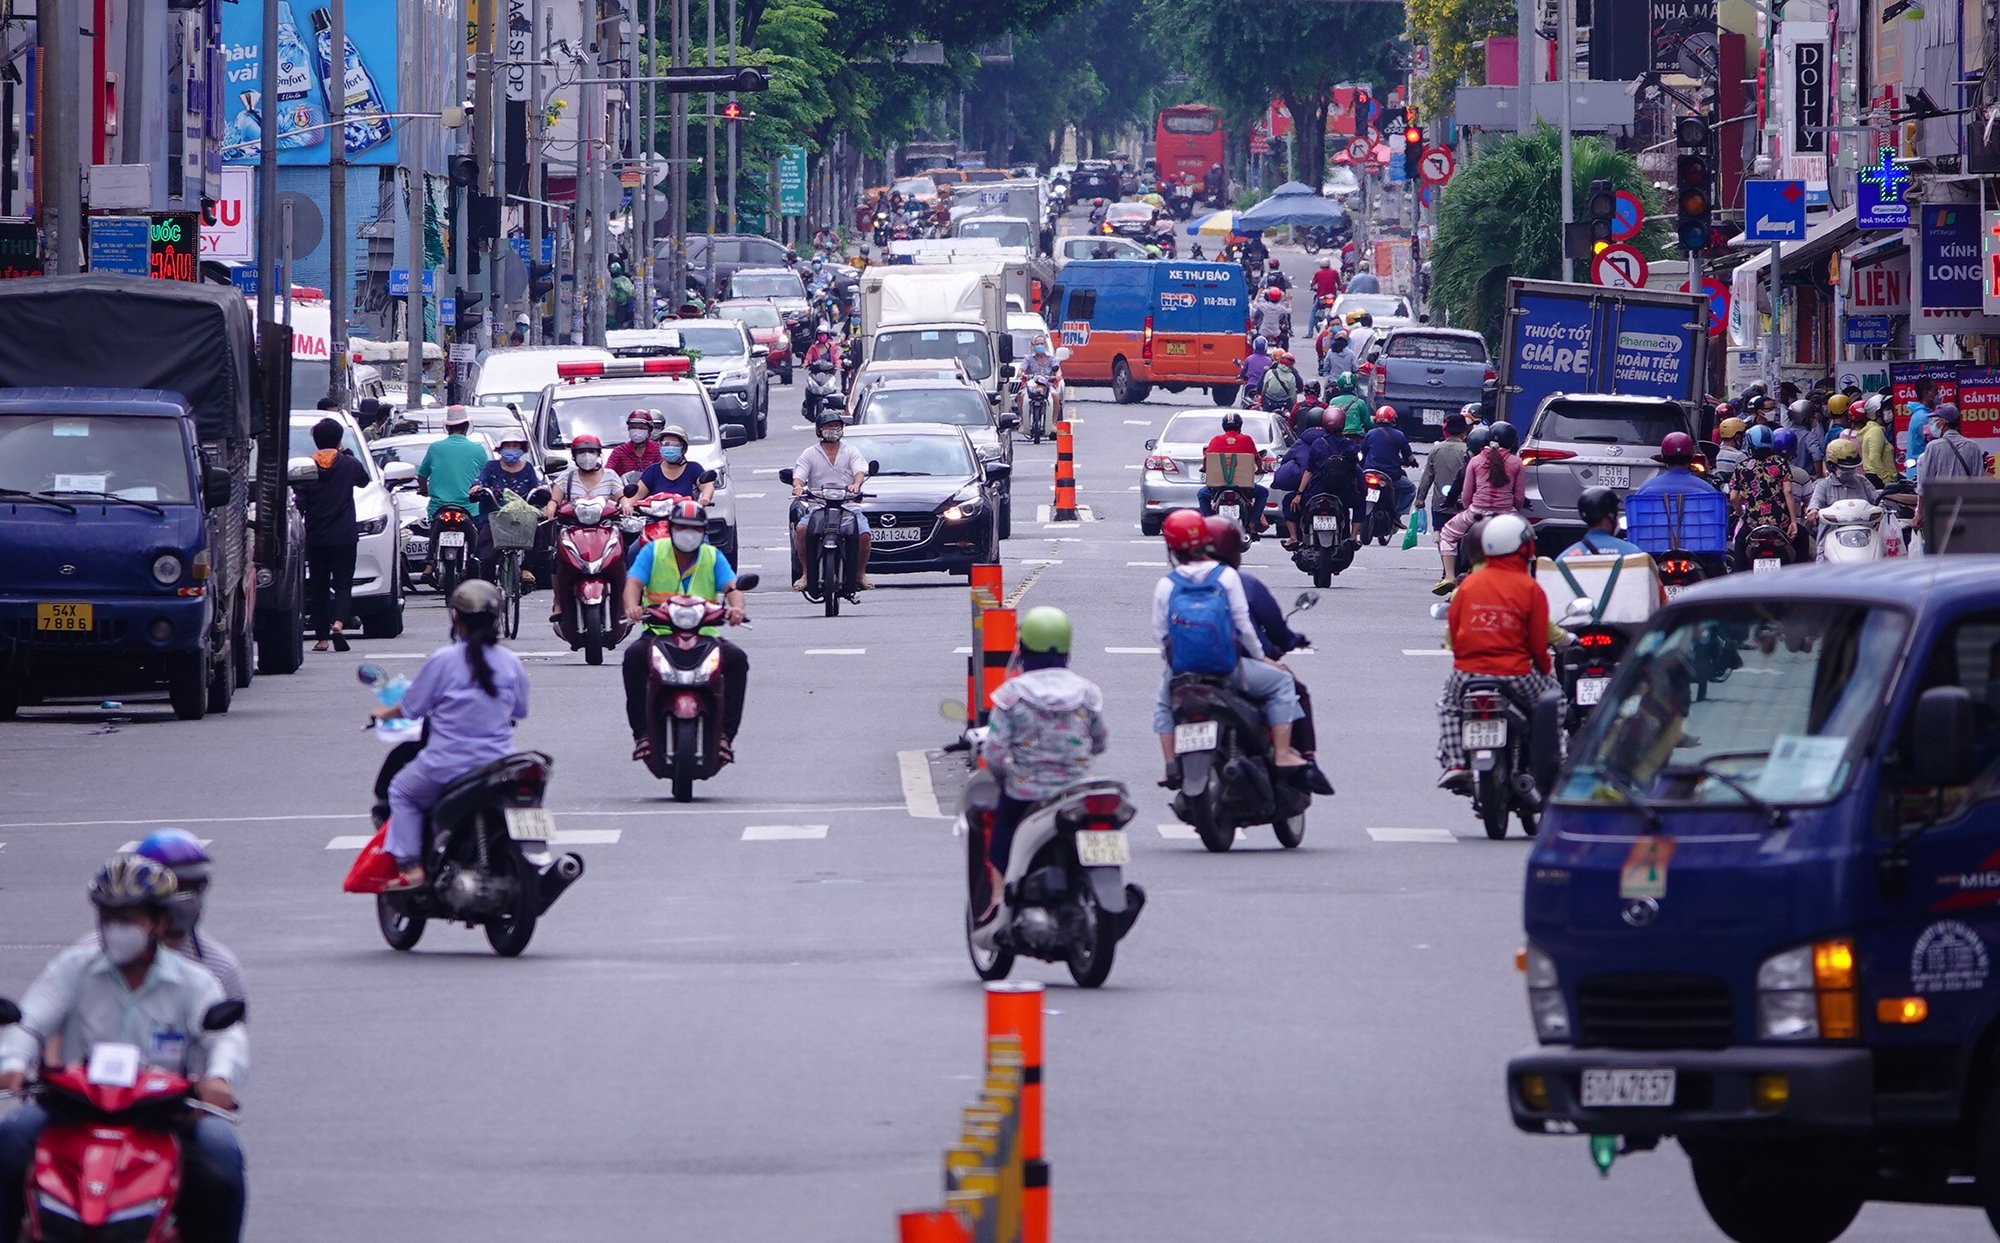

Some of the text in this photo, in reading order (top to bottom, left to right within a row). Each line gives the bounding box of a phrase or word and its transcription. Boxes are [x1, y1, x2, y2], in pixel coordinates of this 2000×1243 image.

[228, 63, 258, 83] vải
[1800, 47, 1819, 148] DOLLY
[1940, 242, 1978, 258] KÍNH
[1169, 270, 1183, 280] XE
[1206, 269, 1231, 282] BÁO
[1929, 264, 1983, 281] LONG
[1525, 322, 1592, 341] THUỐC TỐT
[1521, 340, 1554, 363] GIÁ
[1619, 336, 1678, 352] Pharmacity
[1616, 352, 1680, 370] HOÀN TIỀN
[1614, 367, 1679, 385] CHÊNH LỆCH
[1961, 407, 2000, 421] 1800
[1605, 466, 1622, 476] 51H
[52, 605, 76, 616] 54X
[43, 618, 86, 629] 7886
